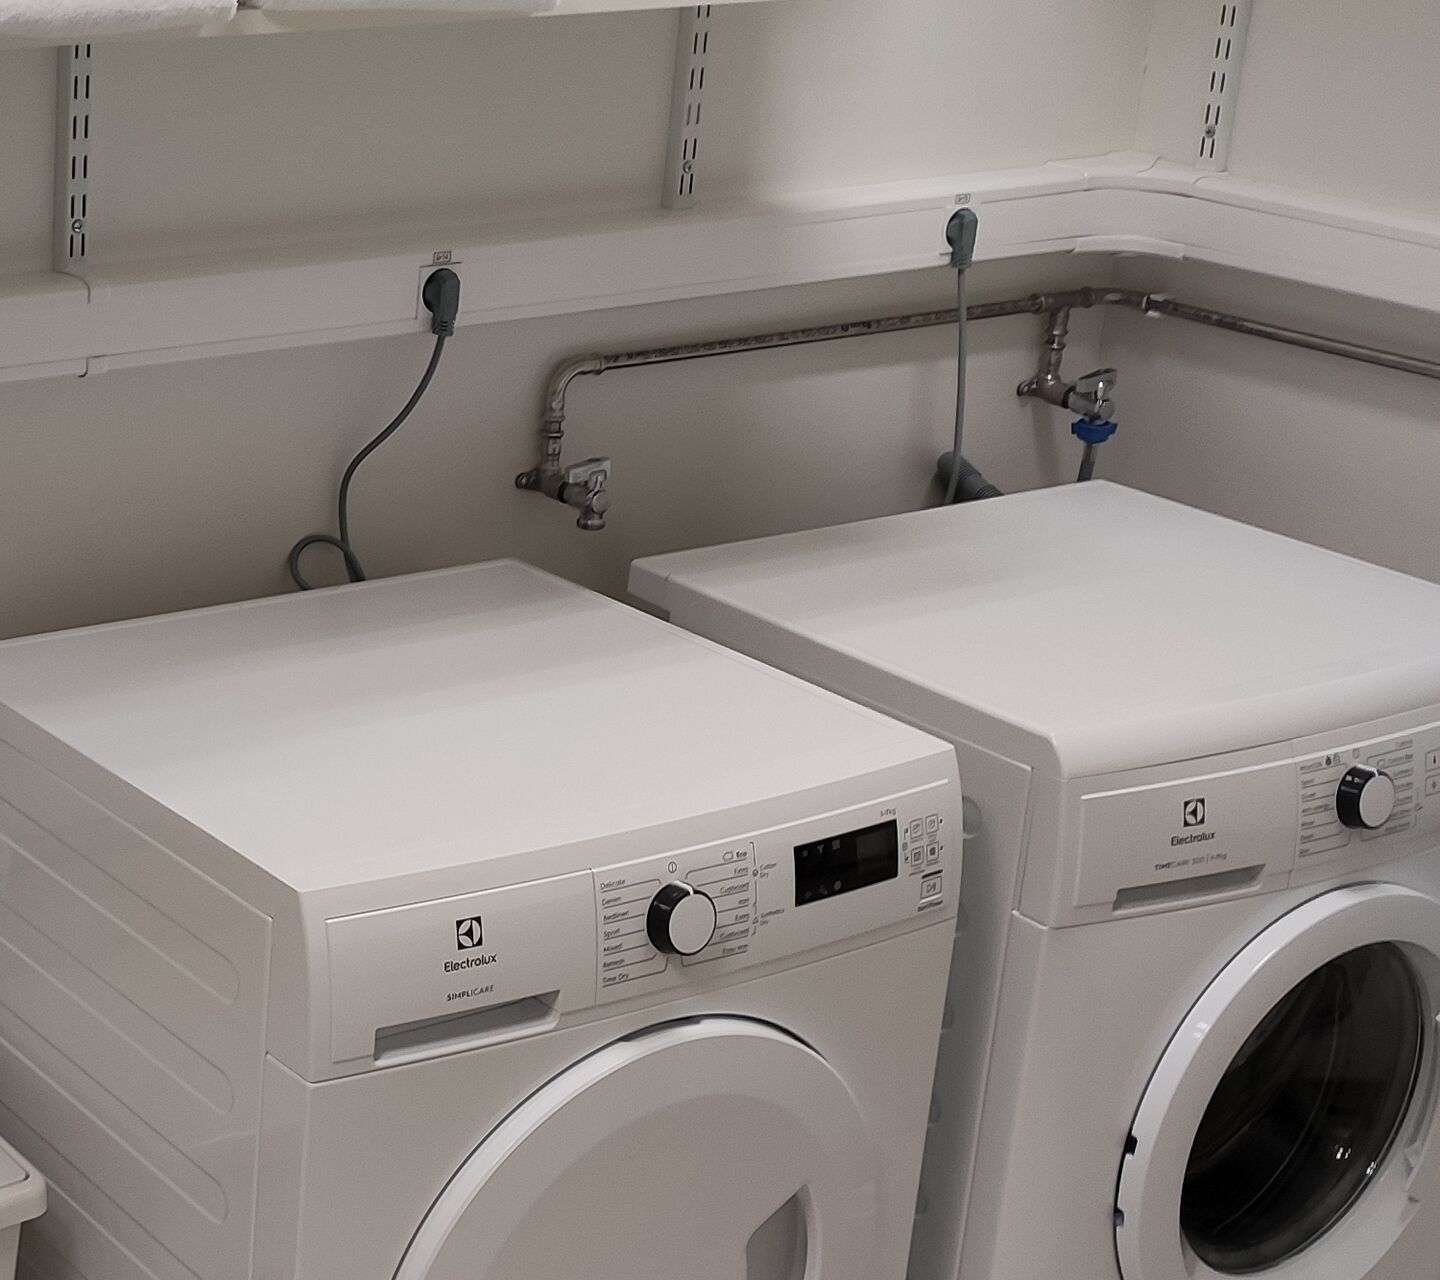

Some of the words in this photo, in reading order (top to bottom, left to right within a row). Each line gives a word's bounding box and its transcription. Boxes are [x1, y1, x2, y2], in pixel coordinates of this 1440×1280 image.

[1170, 832, 1216, 847] Electrolux
[443, 954, 497, 973] Electrolux
[446, 984, 495, 1001] SIMPLICARE
